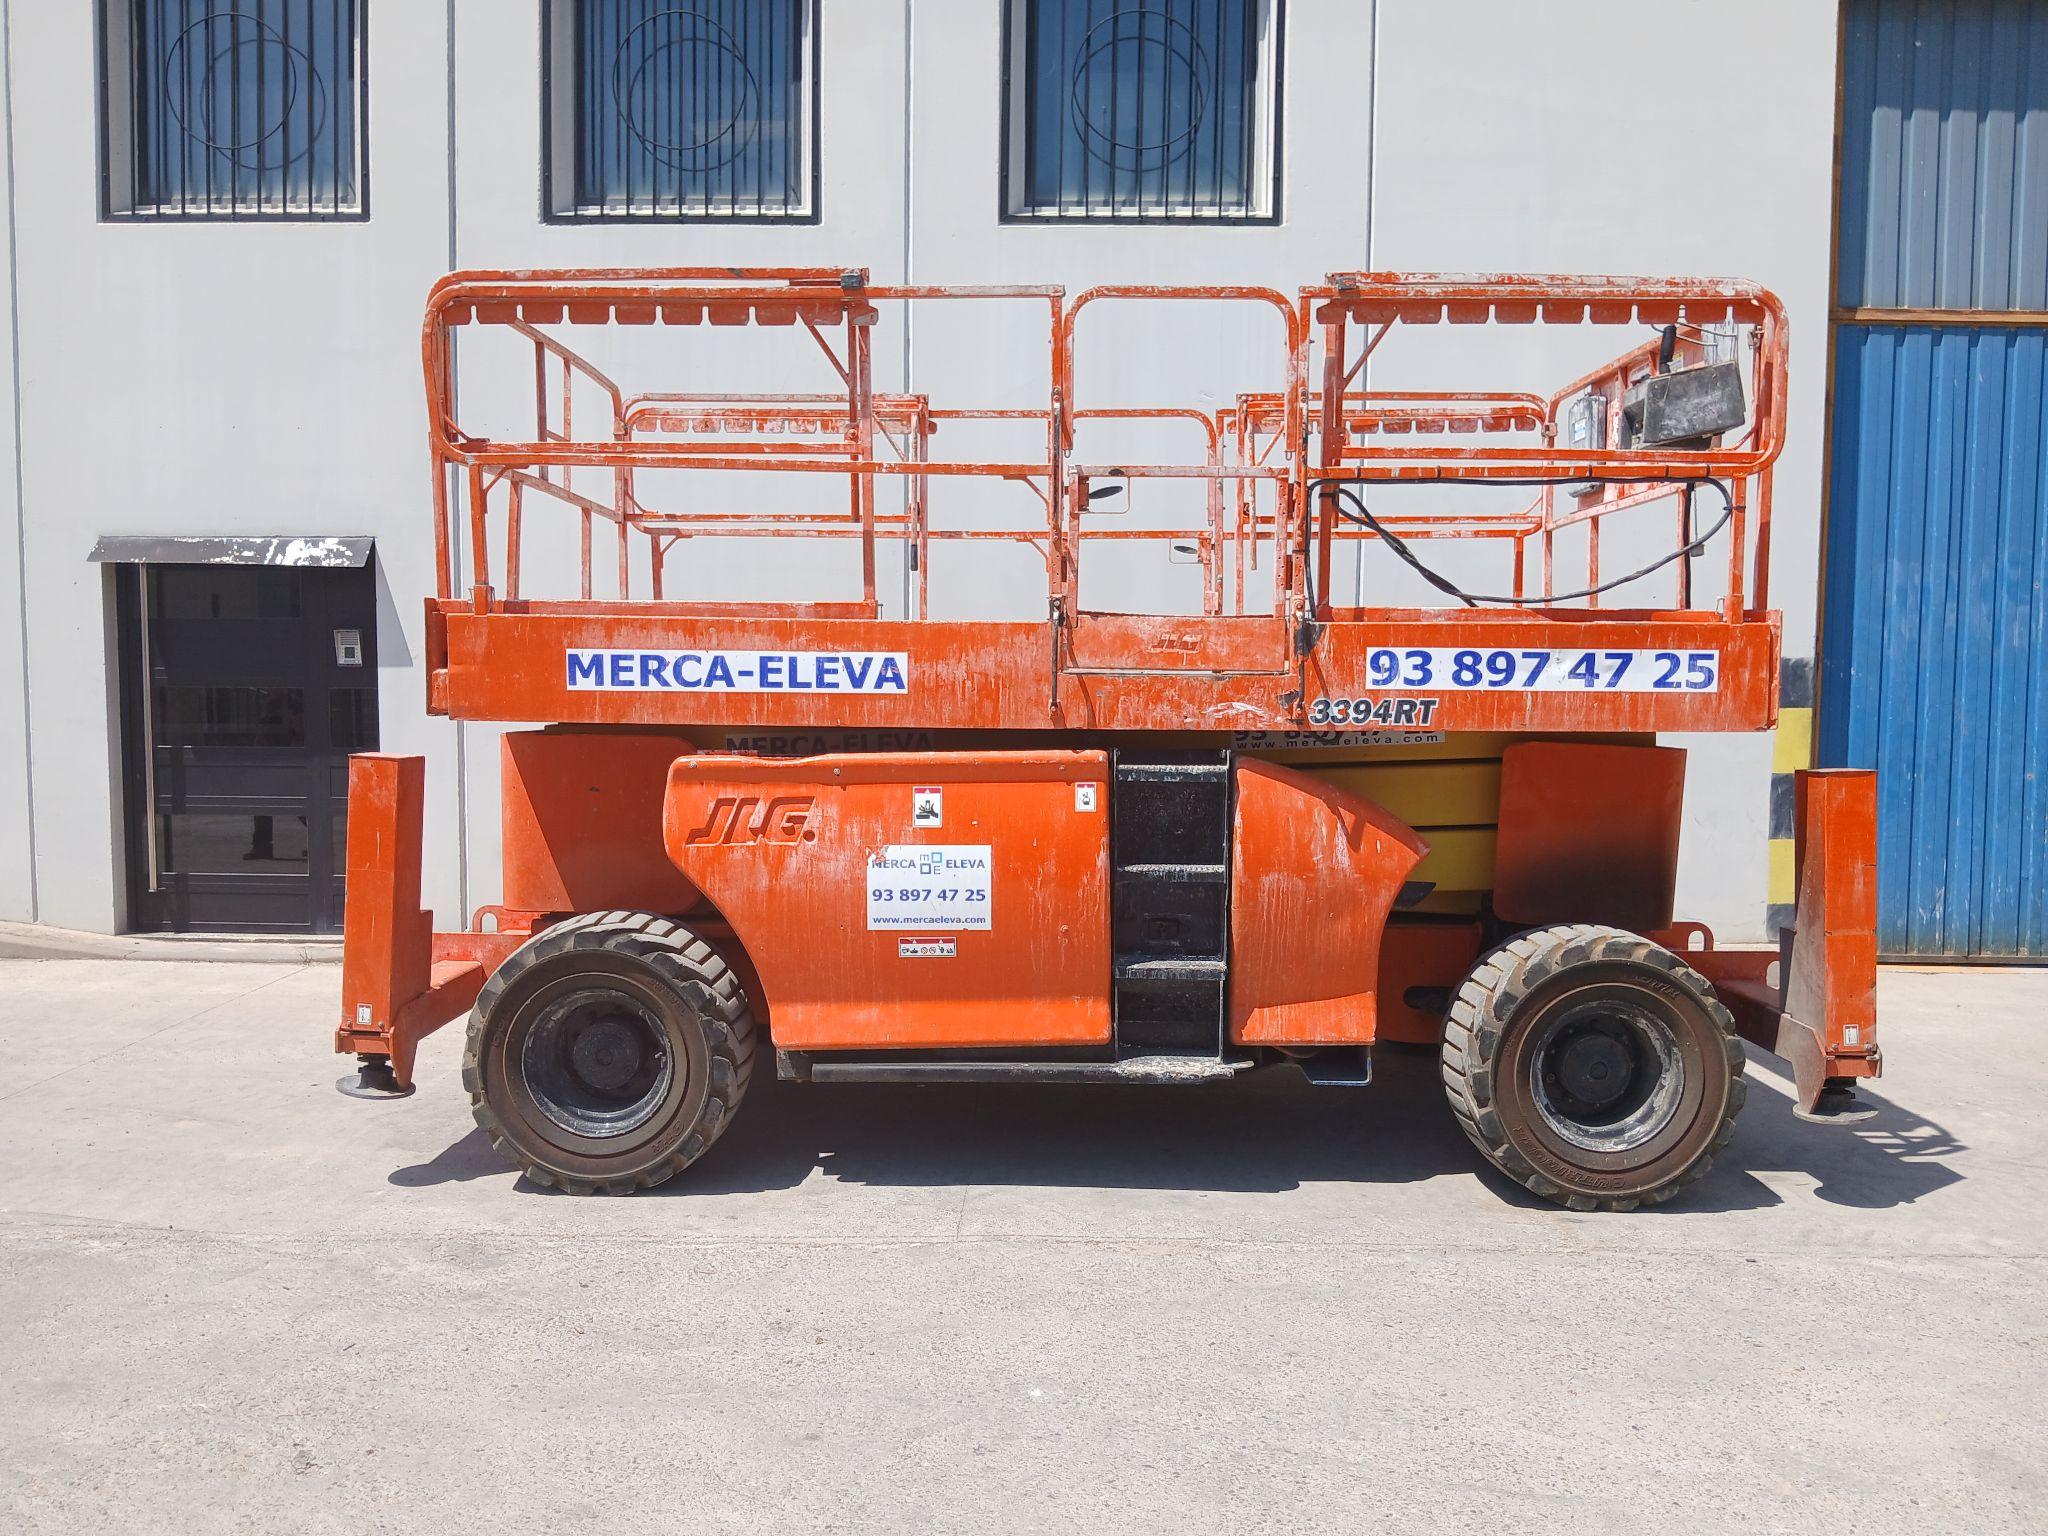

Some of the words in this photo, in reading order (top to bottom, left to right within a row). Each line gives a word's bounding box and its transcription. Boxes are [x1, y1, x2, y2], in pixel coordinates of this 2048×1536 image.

[567, 653, 906, 690] MERCA-ELEVA
[1369, 649, 1433, 687] 93
[1451, 650, 1552, 688] 897
[1567, 652, 1634, 689] 47
[1652, 652, 1716, 690] 25
[1308, 697, 1440, 726] 3394RT
[1236, 735, 1439, 748] www.mereleva.com
[871, 858, 917, 869] MERCA
[945, 859, 986, 869] ELEVA
[872, 888, 894, 902] 93
[899, 888, 932, 902] 897
[937, 888, 959, 902] 47
[964, 888, 986, 902] 25
[872, 915, 986, 924] www.mercaeleva.com
